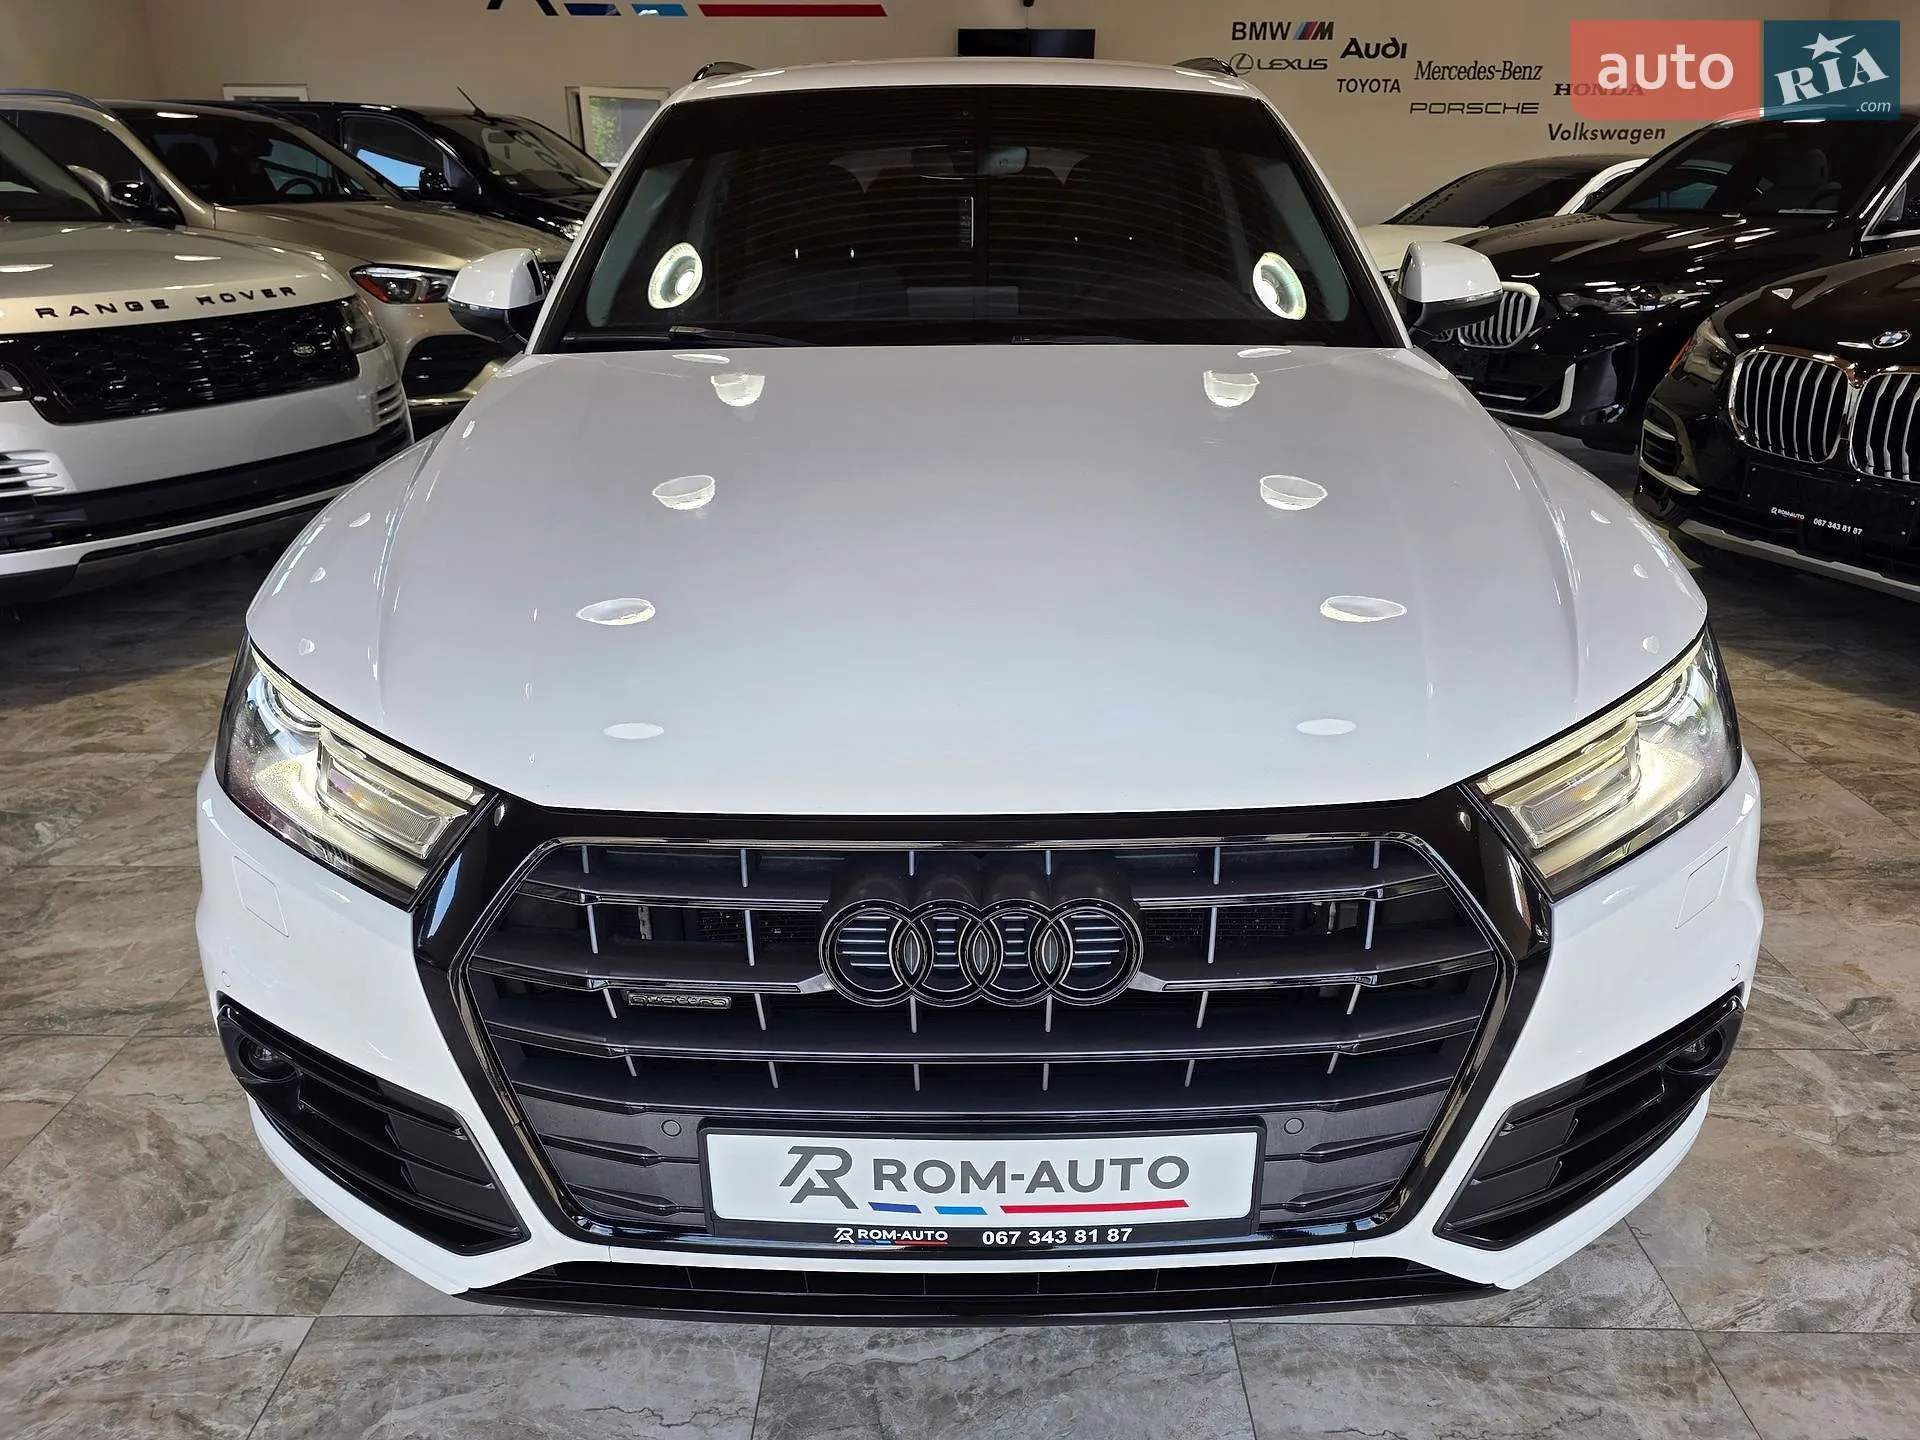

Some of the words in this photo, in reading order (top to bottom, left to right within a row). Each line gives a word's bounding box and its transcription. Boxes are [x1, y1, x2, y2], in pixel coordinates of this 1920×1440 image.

[1231, 21, 1292, 41] BMW
[1339, 36, 1408, 60] Audi
[1257, 58, 1329, 71] LEXUS
[1414, 60, 1544, 82] Mercedes-Benz
[1336, 78, 1401, 94] TOYOTA
[1409, 102, 1540, 115] PORSCHE
[1547, 122, 1666, 145] Volkswagen
[34, 299, 170, 319] RANGE
[195, 286, 297, 306] ROVER
[872, 1155, 1191, 1195] ROM-AUTO
[857, 1228, 949, 1242] ROM-AUTO
[982, 1230, 1021, 1245] 067
[1028, 1229, 1068, 1244] 343
[1074, 1229, 1099, 1243] 81
[1107, 1227, 1134, 1242] 87
